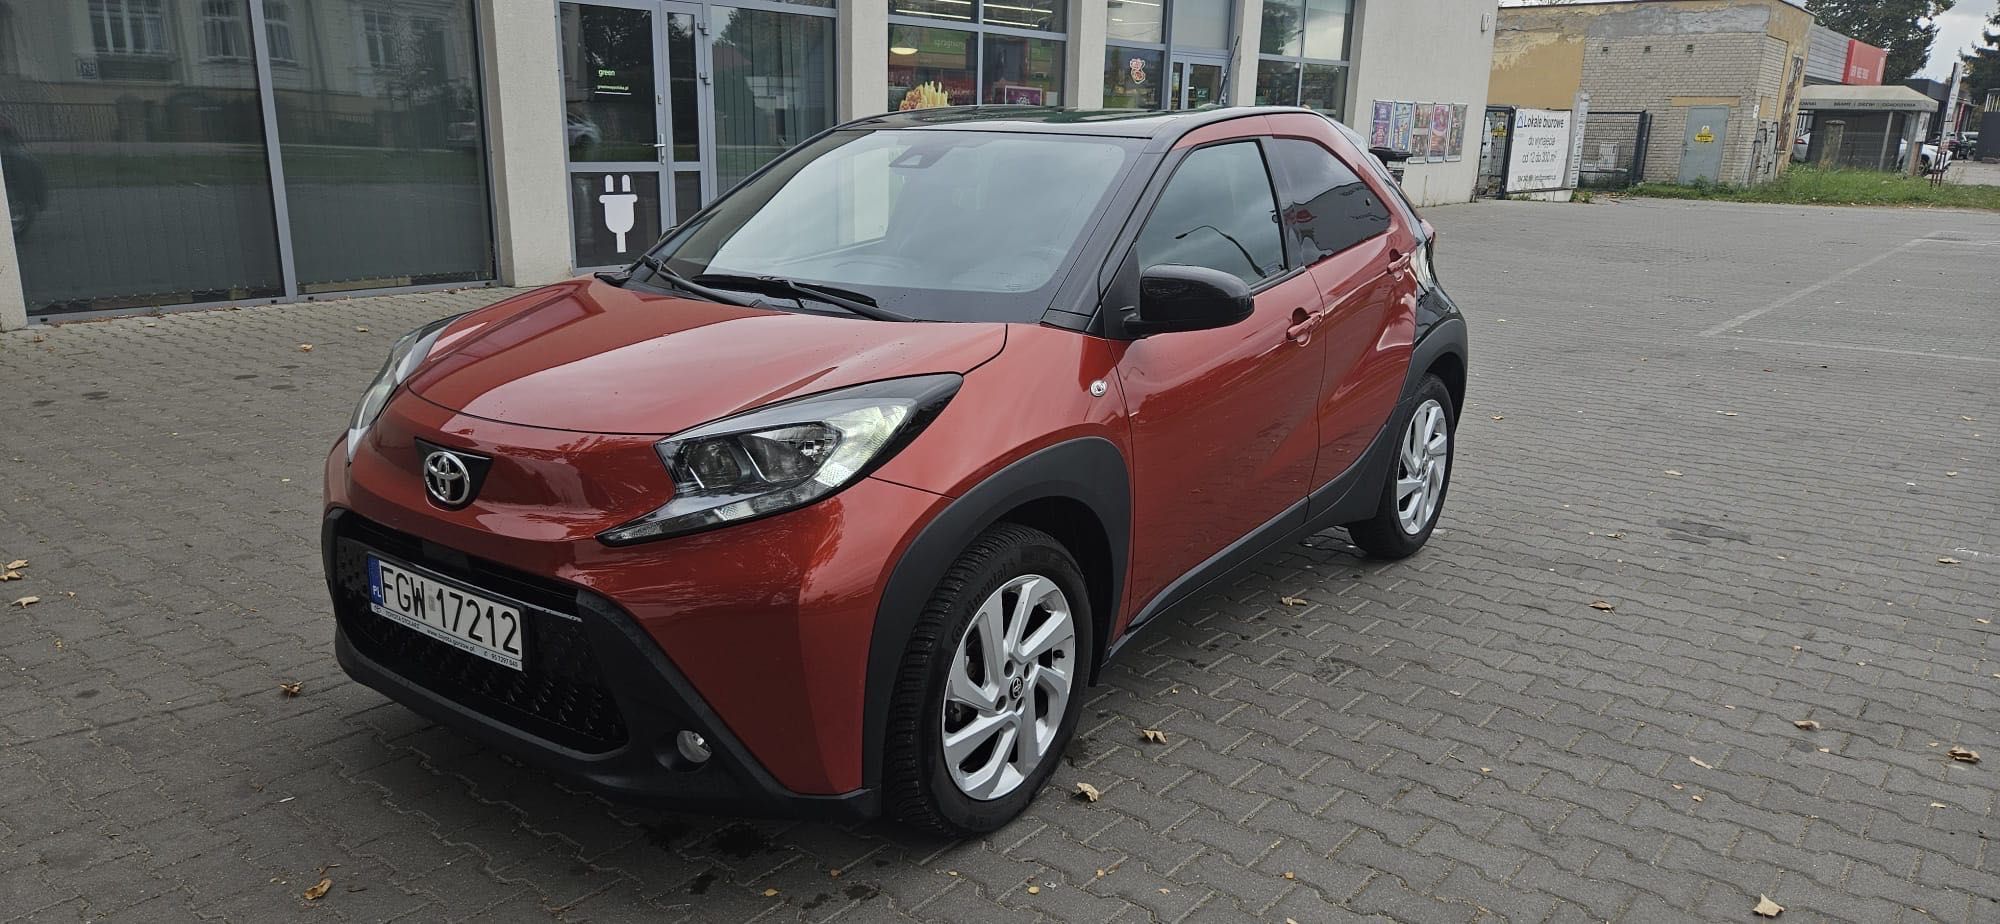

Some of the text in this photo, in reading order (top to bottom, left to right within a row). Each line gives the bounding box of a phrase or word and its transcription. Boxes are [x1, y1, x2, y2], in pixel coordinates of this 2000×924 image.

[598, 69, 616, 77] green
[1523, 114, 1564, 128] Lokale biurowe
[372, 586, 382, 598] PL
[380, 565, 519, 655] FGW 17212
[385, 610, 401, 624] TOYOTA
